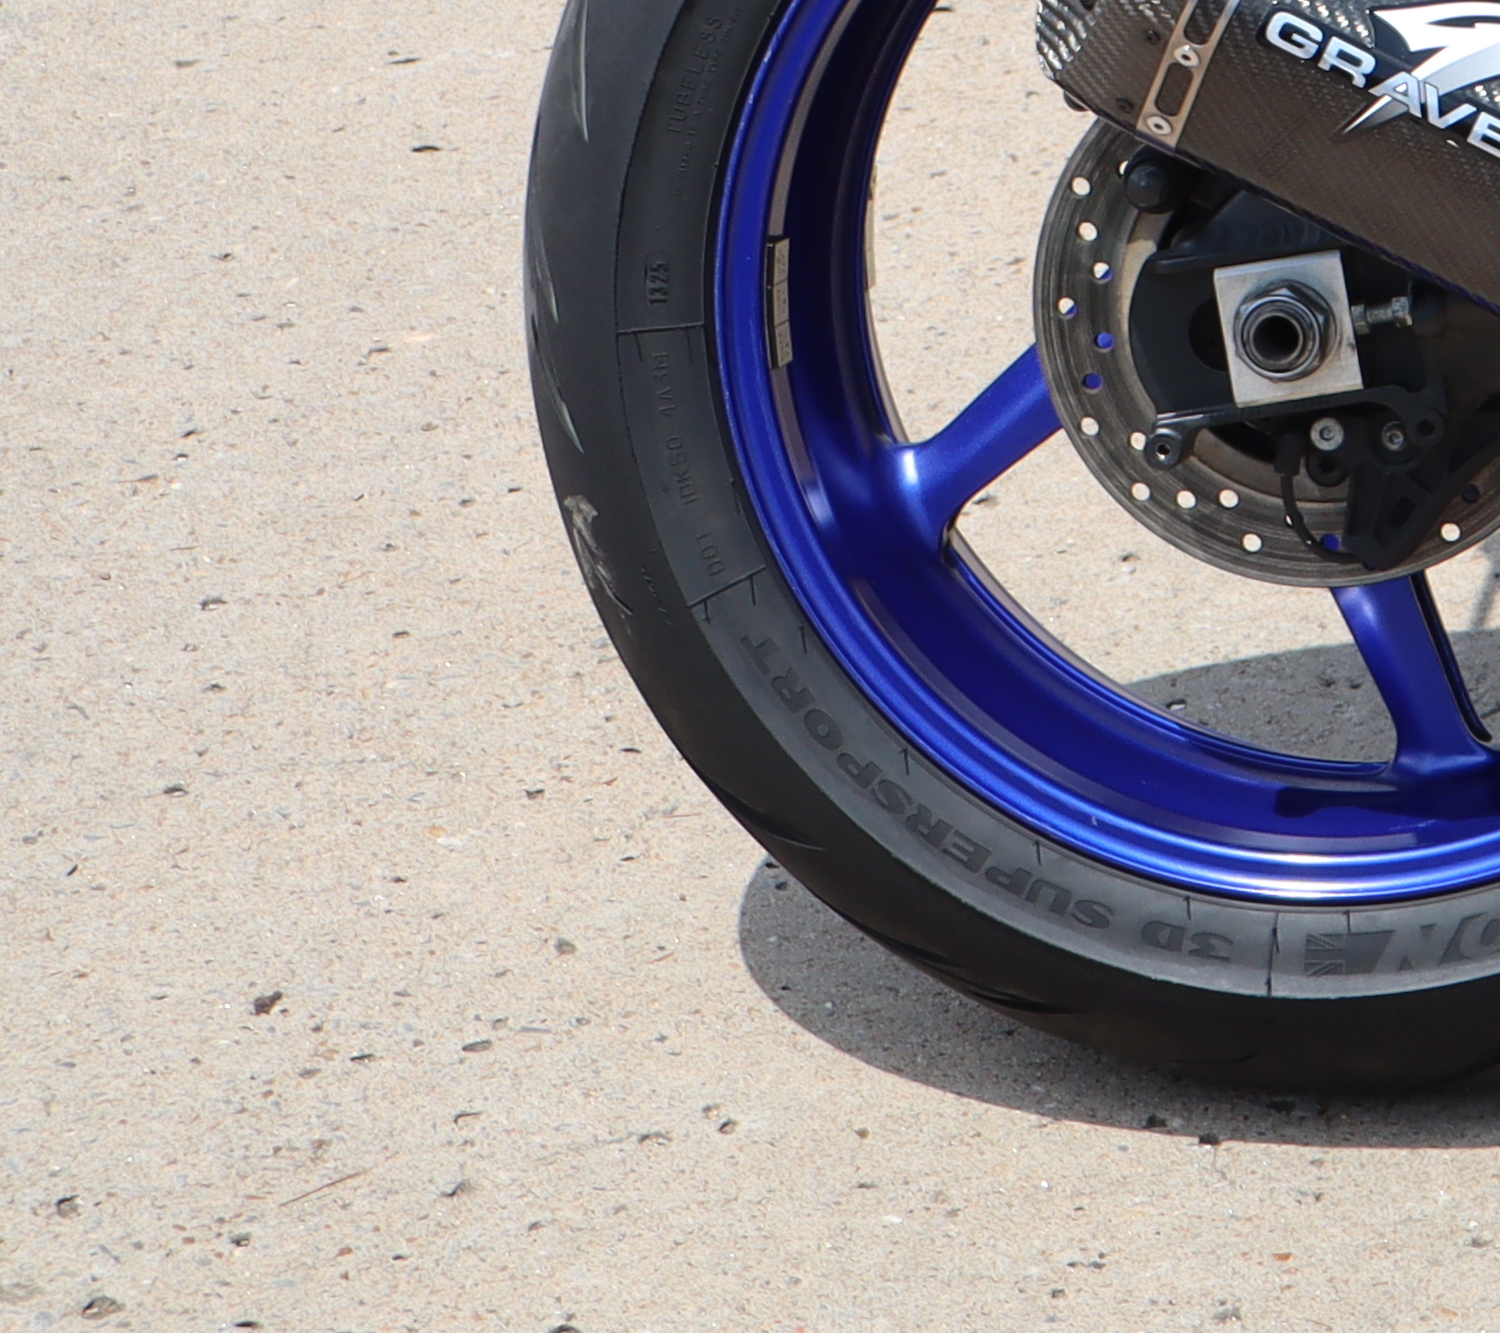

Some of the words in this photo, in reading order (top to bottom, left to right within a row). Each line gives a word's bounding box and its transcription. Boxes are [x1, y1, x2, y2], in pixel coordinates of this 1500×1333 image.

[666, 14, 725, 136] TUBELESS
[695, 532, 726, 578] DOT
[739, 632, 1115, 930] SUPERSPORT
[1141, 920, 1233, 963] 3D
